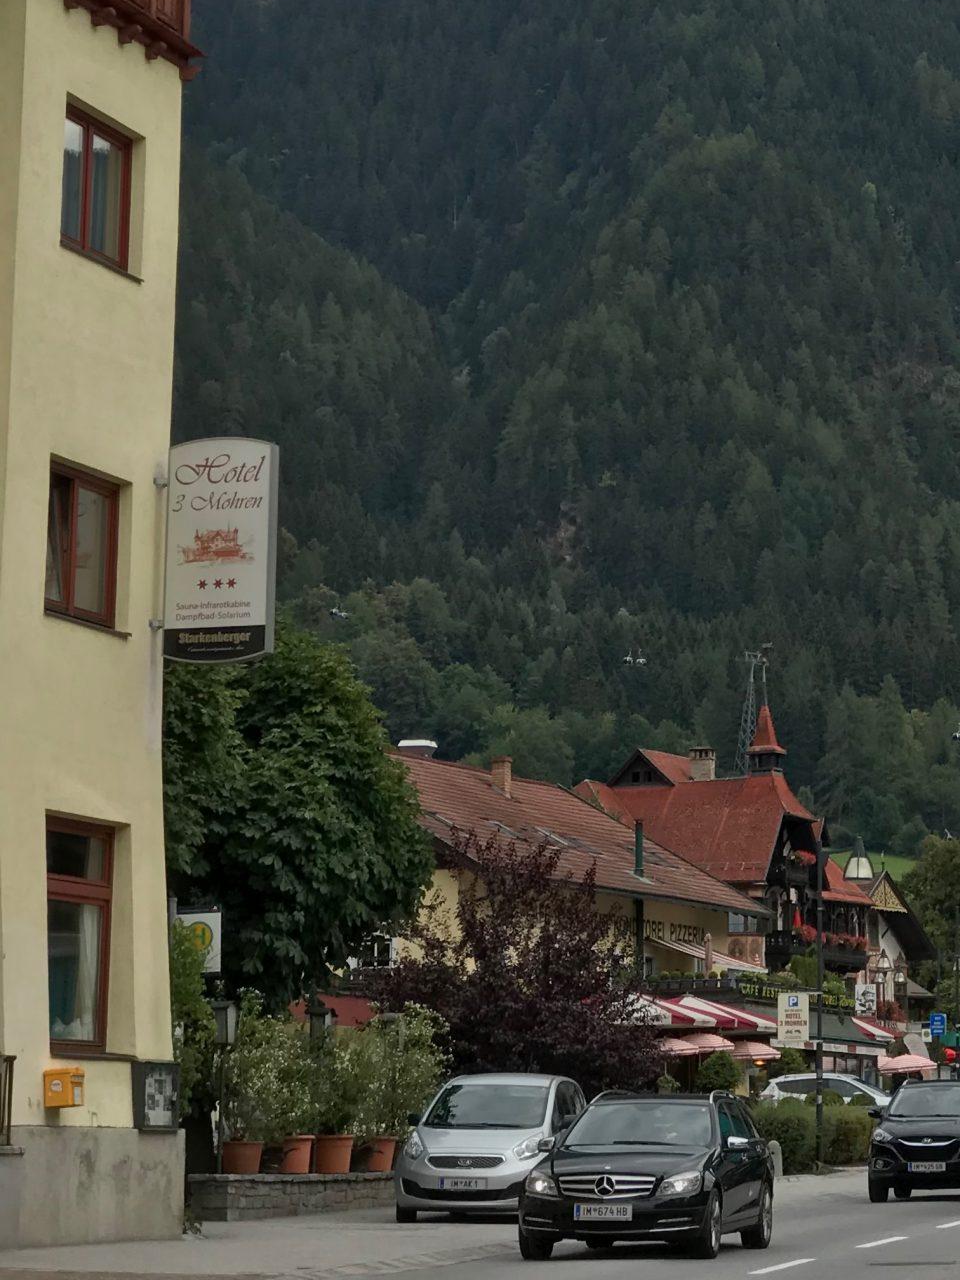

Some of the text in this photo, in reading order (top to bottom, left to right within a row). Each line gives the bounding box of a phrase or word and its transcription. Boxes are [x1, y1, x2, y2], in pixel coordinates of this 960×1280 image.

[175, 454, 266, 485] Hotel
[172, 491, 263, 513] 3 Mohren
[670, 923, 706, 945] PIZZERIA
[582, 1206, 628, 1216] IM 674 HB
